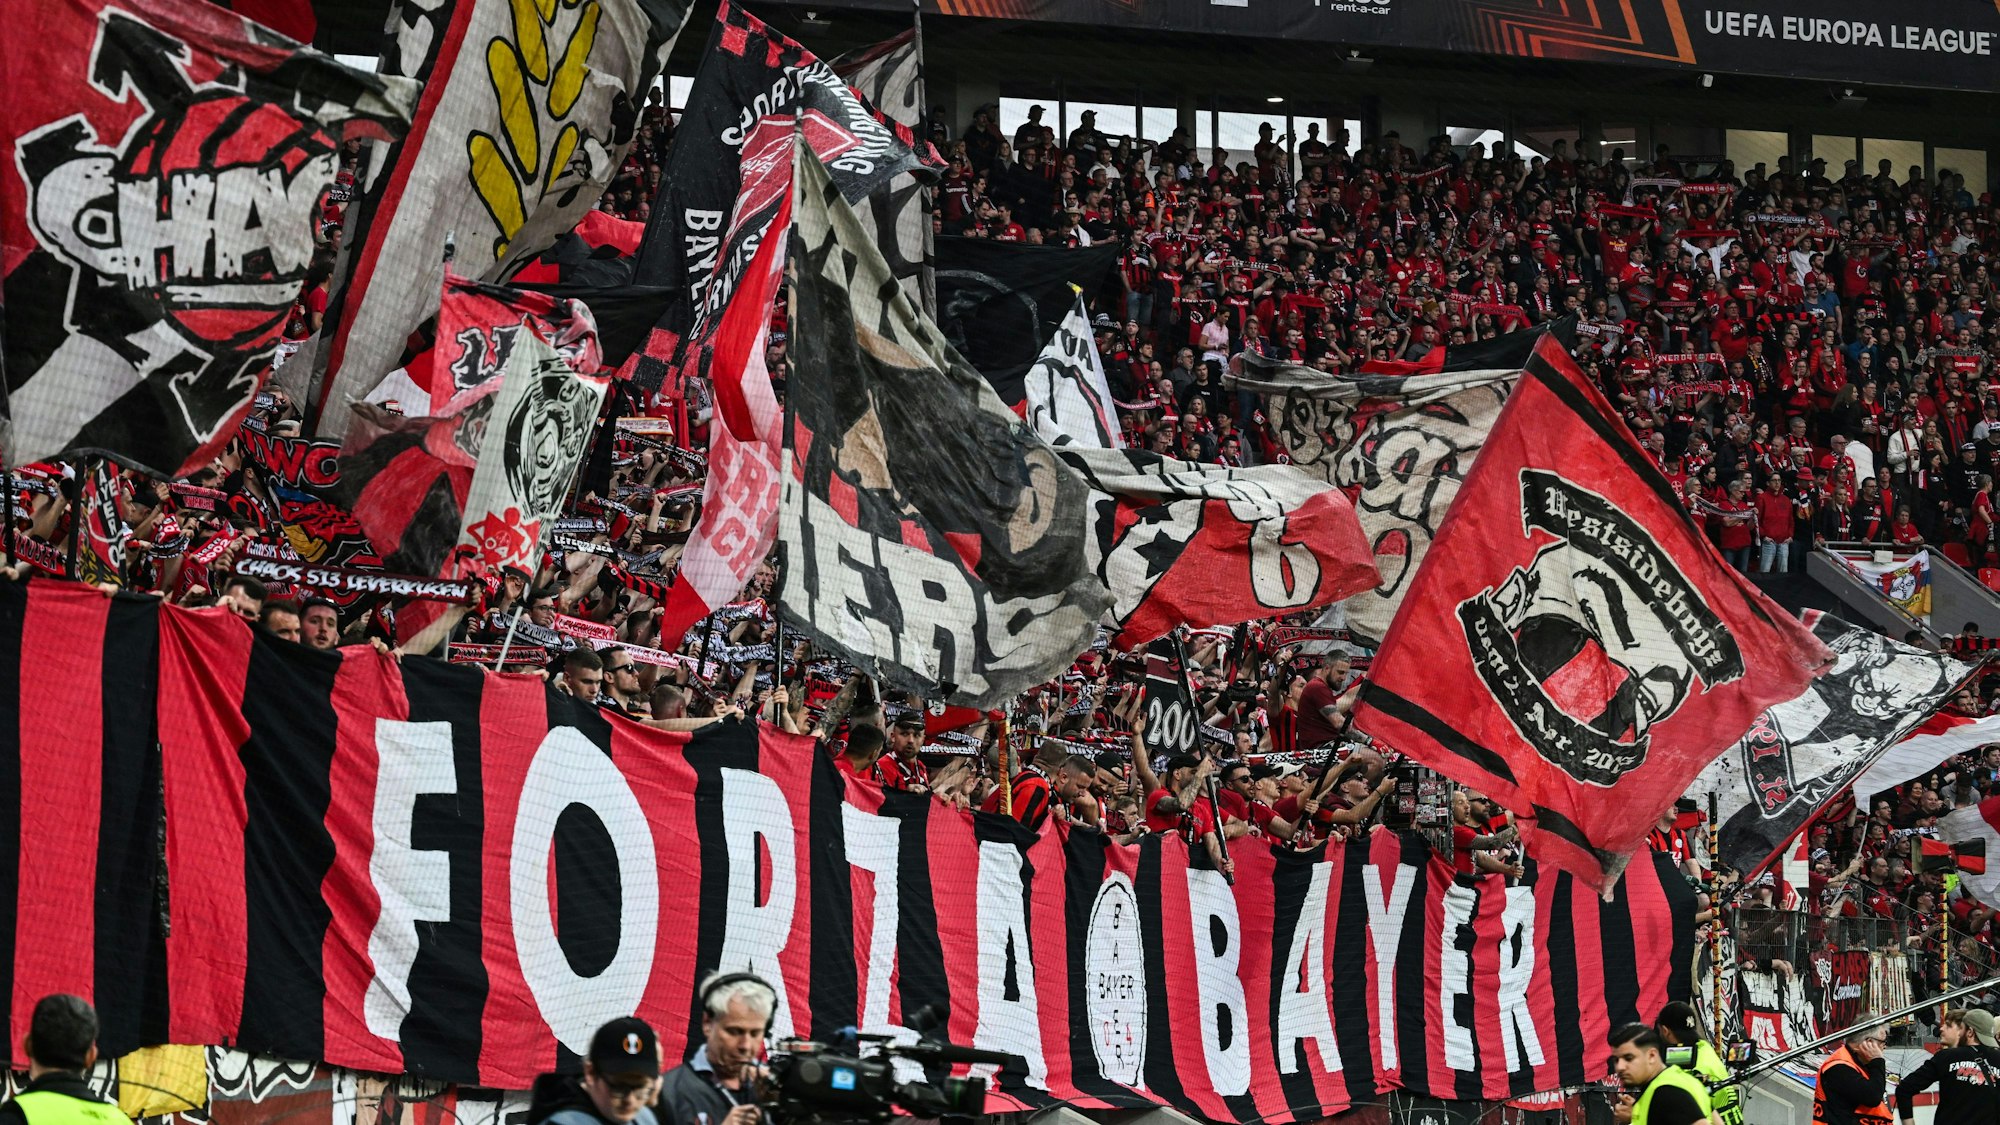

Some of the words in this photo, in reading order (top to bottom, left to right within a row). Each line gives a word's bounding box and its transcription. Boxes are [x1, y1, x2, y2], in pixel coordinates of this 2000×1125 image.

[1330, 3, 1391, 15] rent-a-car
[1705, 10, 1775, 38] UEFA
[1782, 16, 1884, 47] EUROPA
[236, 558, 303, 584] CHAOS
[306, 568, 341, 588] 513
[363, 718, 1051, 1091] FORZA
[1185, 860, 1547, 1097] BAYER
[1099, 972, 1134, 999] BAYER
